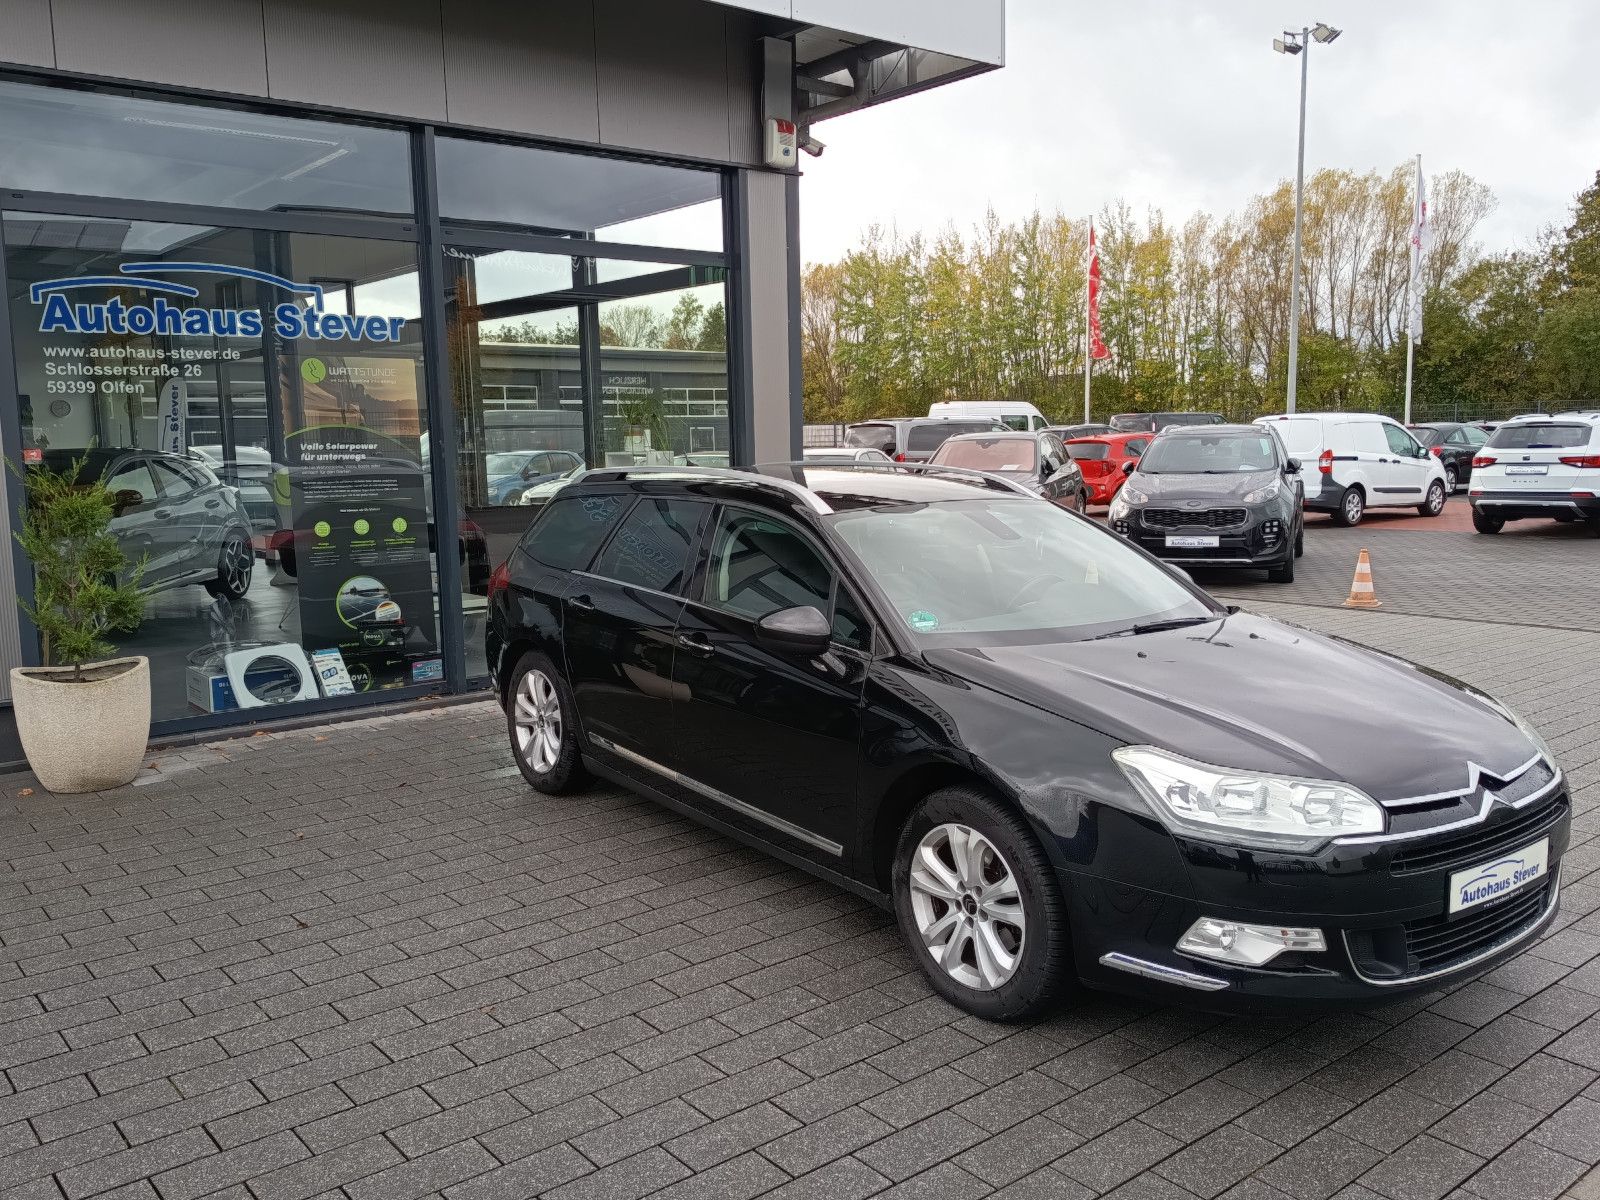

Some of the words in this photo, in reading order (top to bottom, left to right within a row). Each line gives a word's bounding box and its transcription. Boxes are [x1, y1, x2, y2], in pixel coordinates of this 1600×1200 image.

[39, 294, 263, 338] Autohaus
[275, 303, 405, 343] Stever
[43, 346, 240, 361] www.autohaus-stever.de
[45, 362, 180, 378] Schlosserstraße
[184, 364, 202, 378] 26
[328, 366, 397, 377] WATTSTUNDE
[46, 381, 96, 394] 59399
[101, 381, 145, 395] Olfen
[170, 384, 179, 432] Stever
[326, 443, 378, 454] Solarpower
[300, 453, 316, 461] für
[317, 453, 367, 462] unterwegs
[1461, 877, 1511, 906] Autohaus
[1513, 863, 1540, 885] Stever
